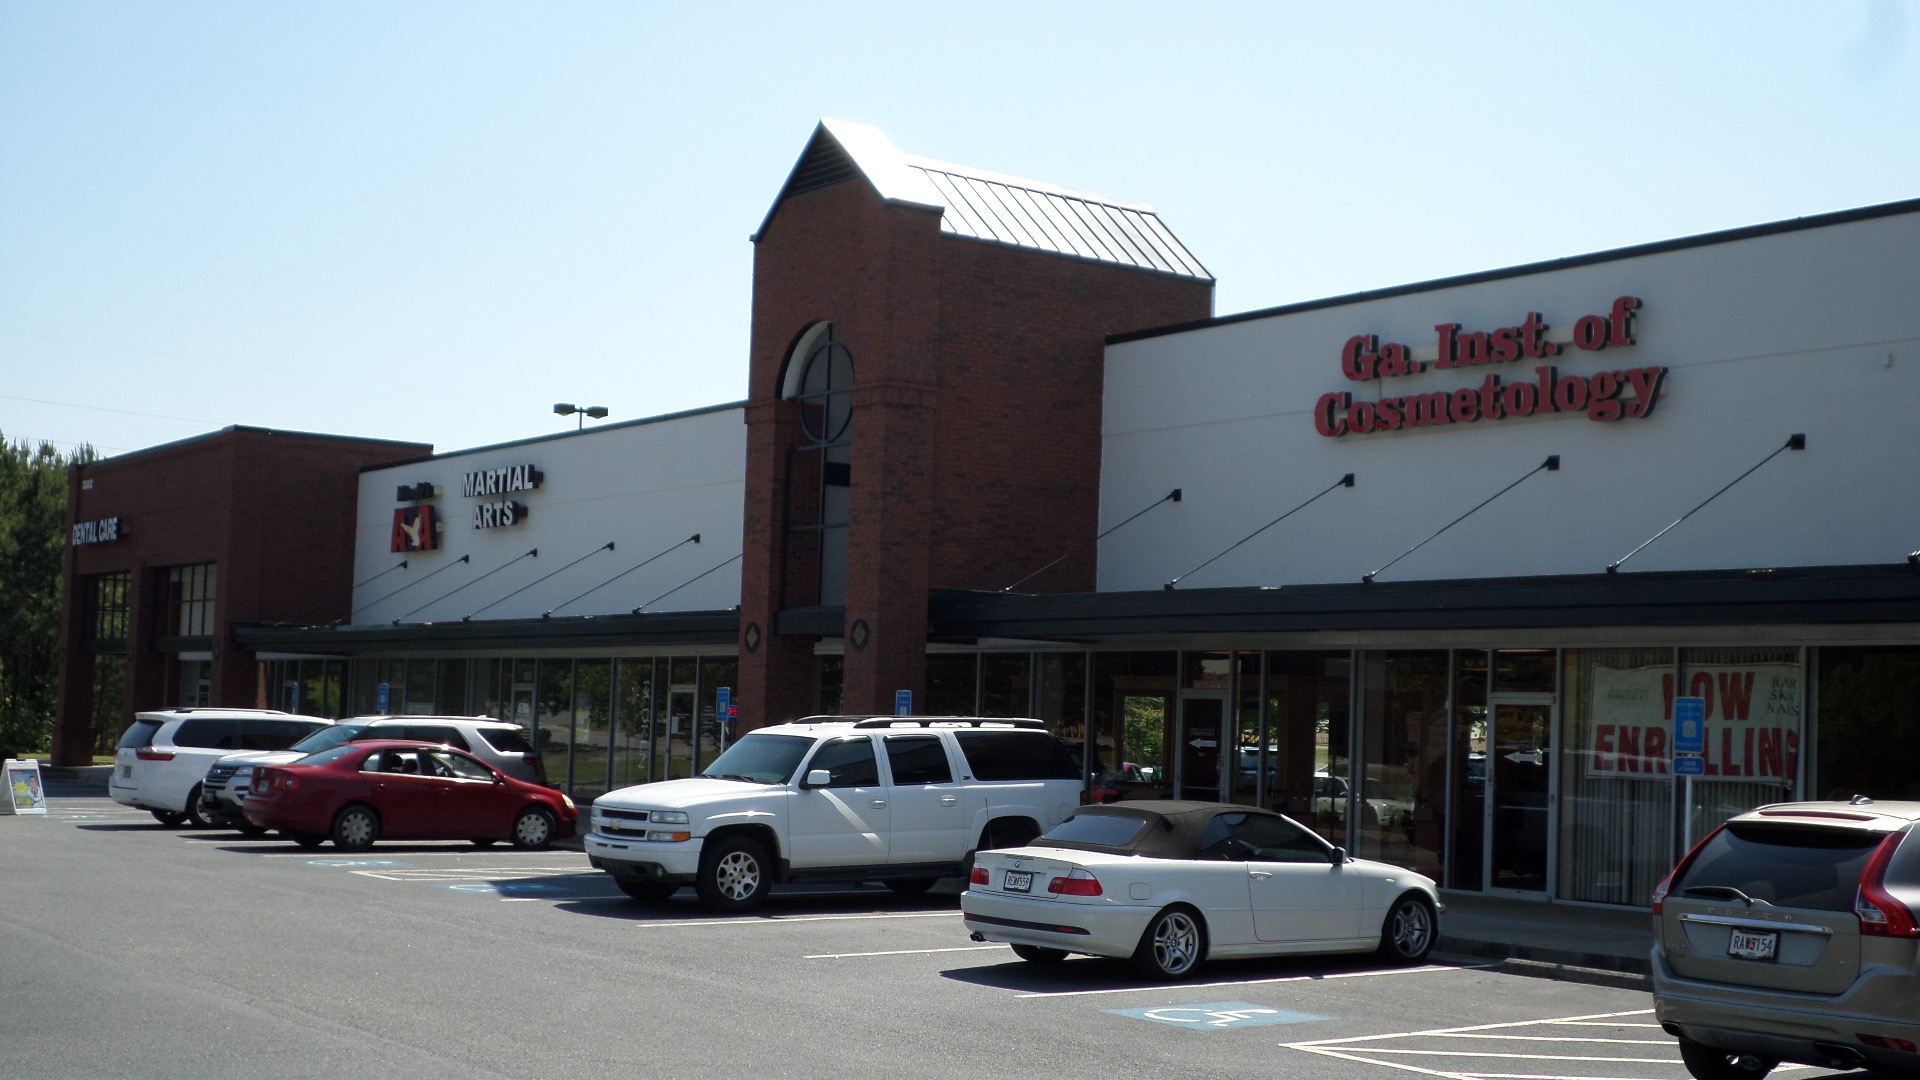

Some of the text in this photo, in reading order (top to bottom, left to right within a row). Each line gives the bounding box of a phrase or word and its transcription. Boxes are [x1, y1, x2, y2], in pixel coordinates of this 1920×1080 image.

[1341, 295, 1642, 381] Ga. Inst. of
[1314, 365, 1669, 437] Cosmetology
[462, 464, 534, 497] MARTIAL
[72, 517, 118, 545] DENTAL CARE
[474, 500, 515, 530] ARTS
[1767, 703, 1799, 717] NAS
[1594, 724, 1800, 781] ENRLLING
